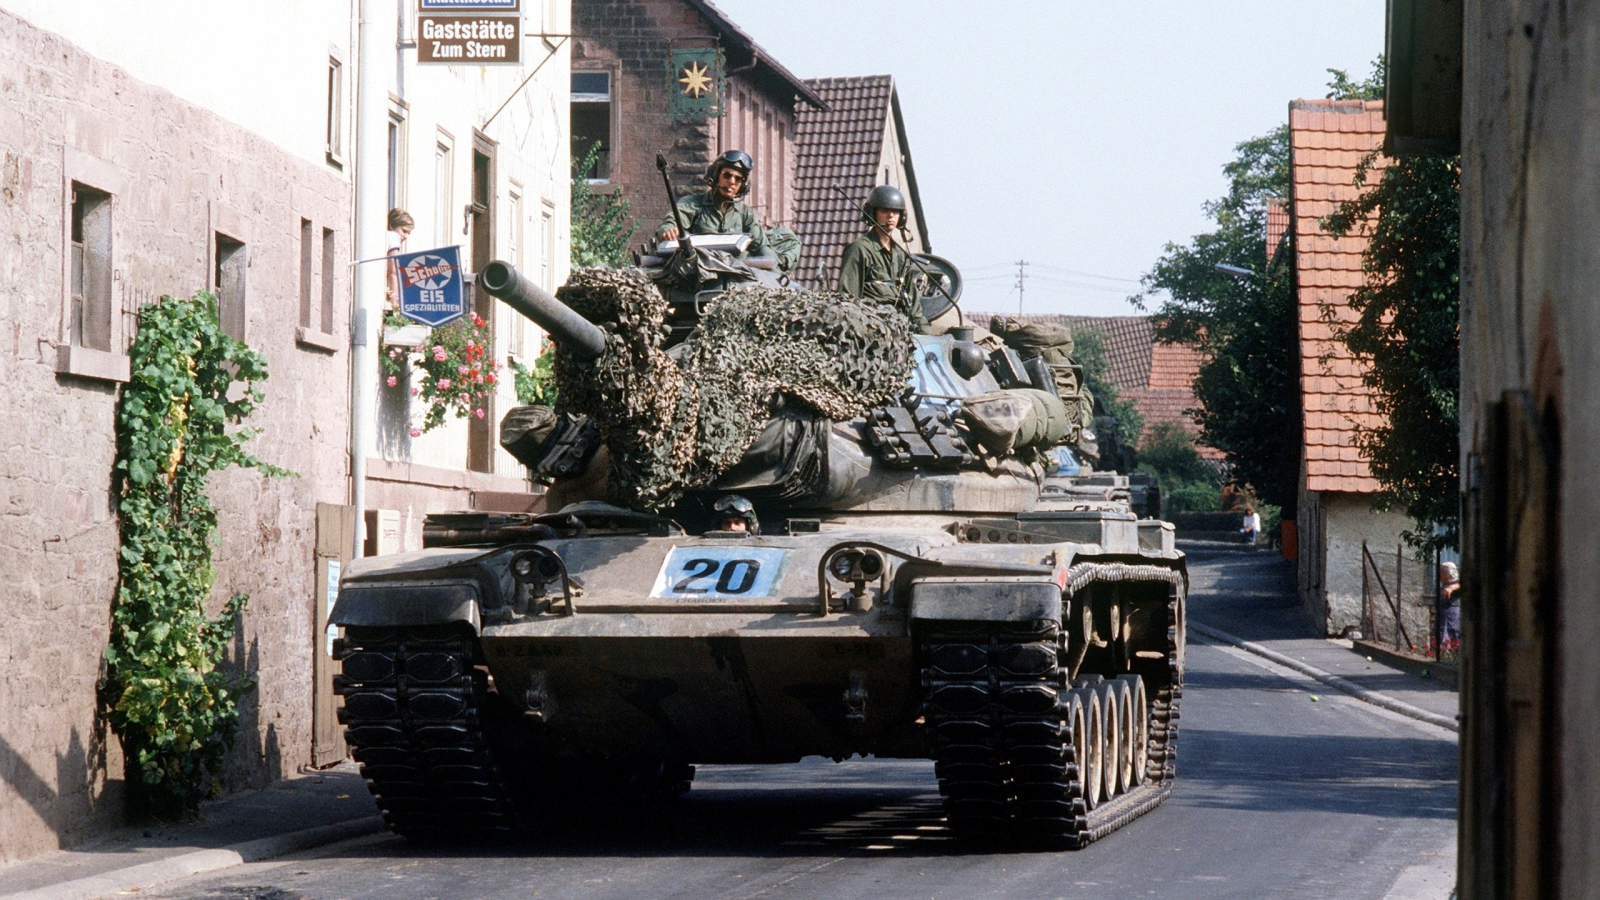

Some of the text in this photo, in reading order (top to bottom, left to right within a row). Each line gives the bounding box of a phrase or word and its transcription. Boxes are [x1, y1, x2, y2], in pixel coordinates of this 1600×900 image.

[423, 19, 515, 39] Gaststätte
[432, 41, 505, 57] Zum Stern
[420, 290, 444, 303] EIS
[405, 303, 460, 312] SPEZIALITÄTEN
[672, 558, 760, 594] 20
